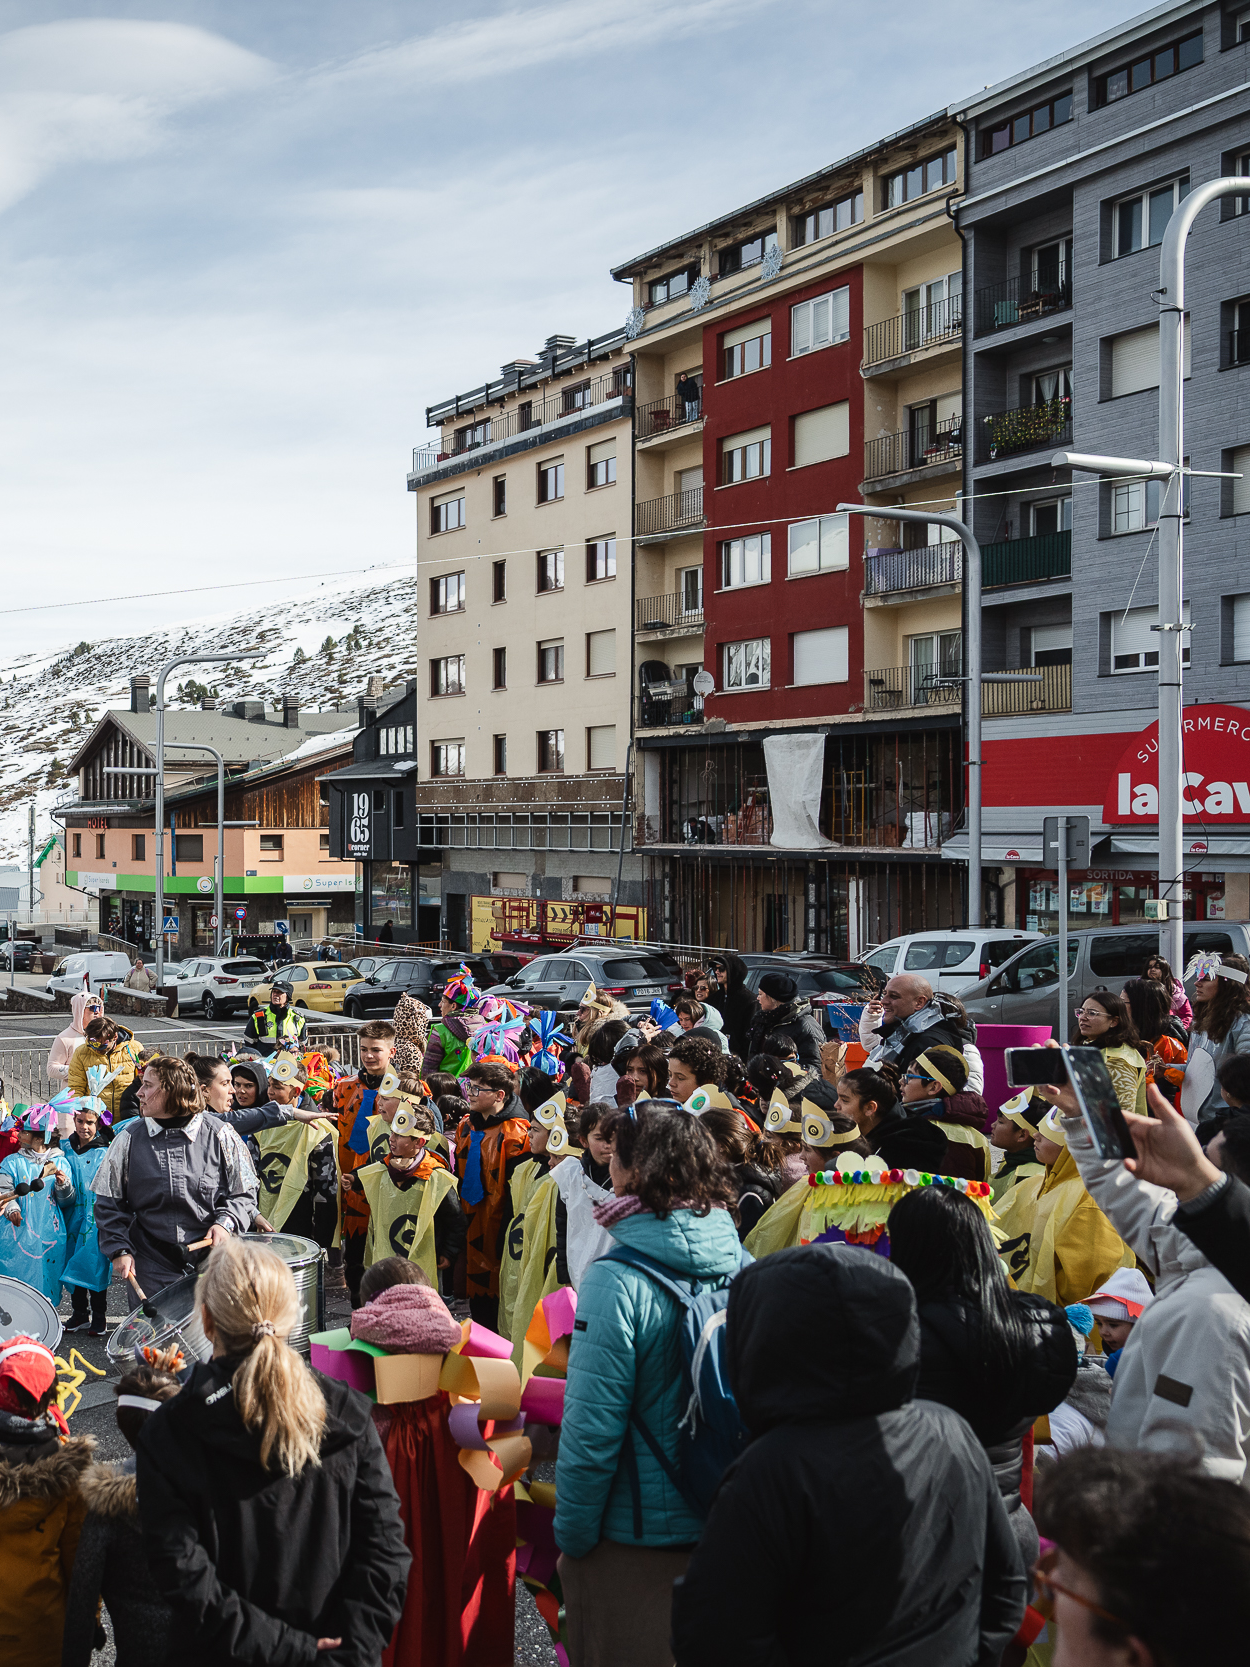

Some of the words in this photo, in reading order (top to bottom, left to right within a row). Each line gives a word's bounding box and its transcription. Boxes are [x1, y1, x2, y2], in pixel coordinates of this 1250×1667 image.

[1137, 716, 1250, 763] SURMERC
[352, 793, 369, 818] 19
[88, 817, 107, 829] HOTEL
[351, 816, 370, 842] 65
[315, 878, 342, 888] Super
[1087, 870, 1134, 880] SORTIDA
